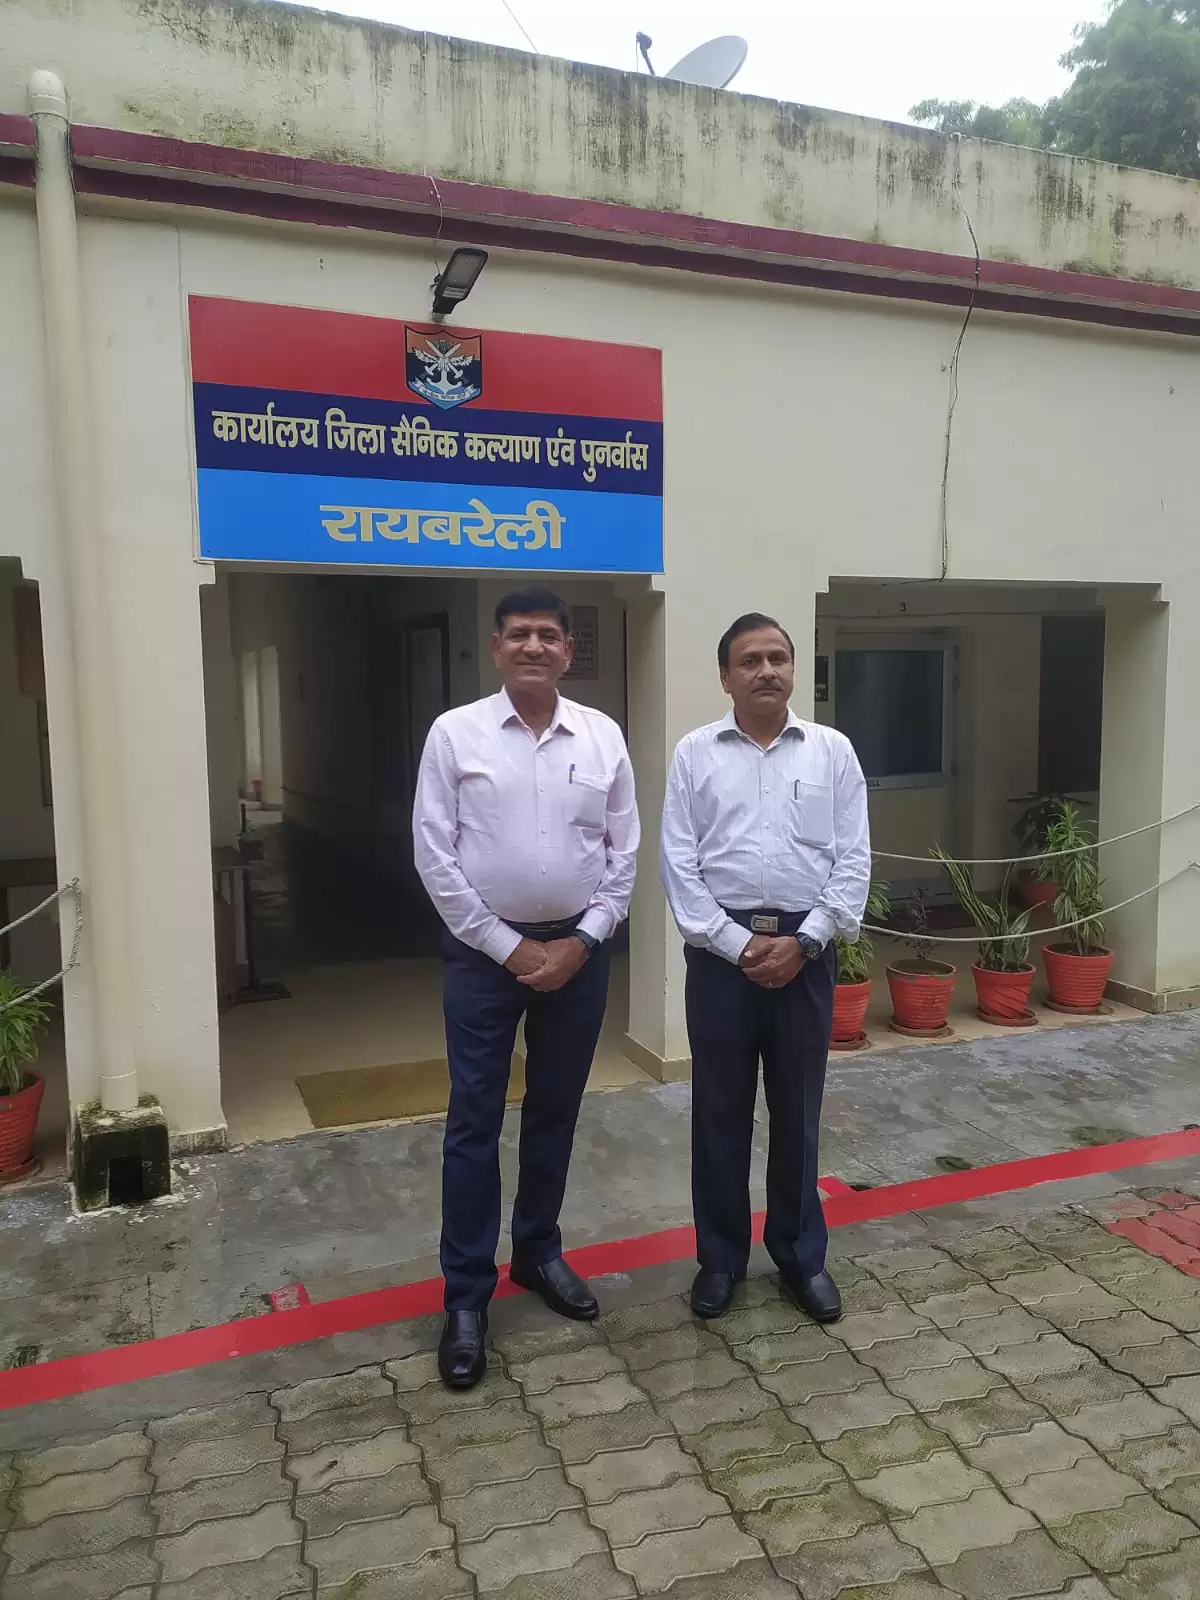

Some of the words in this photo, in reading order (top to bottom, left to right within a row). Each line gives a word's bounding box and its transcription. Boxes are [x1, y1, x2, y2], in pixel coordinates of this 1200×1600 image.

[211, 402, 319, 448] कार्यालय
[325, 407, 386, 454] जिला
[390, 414, 459, 458] सैनिक
[464, 432, 541, 463] कल्याण
[580, 430, 649, 483] पुनर्वास
[319, 498, 567, 550] रायबरेली
